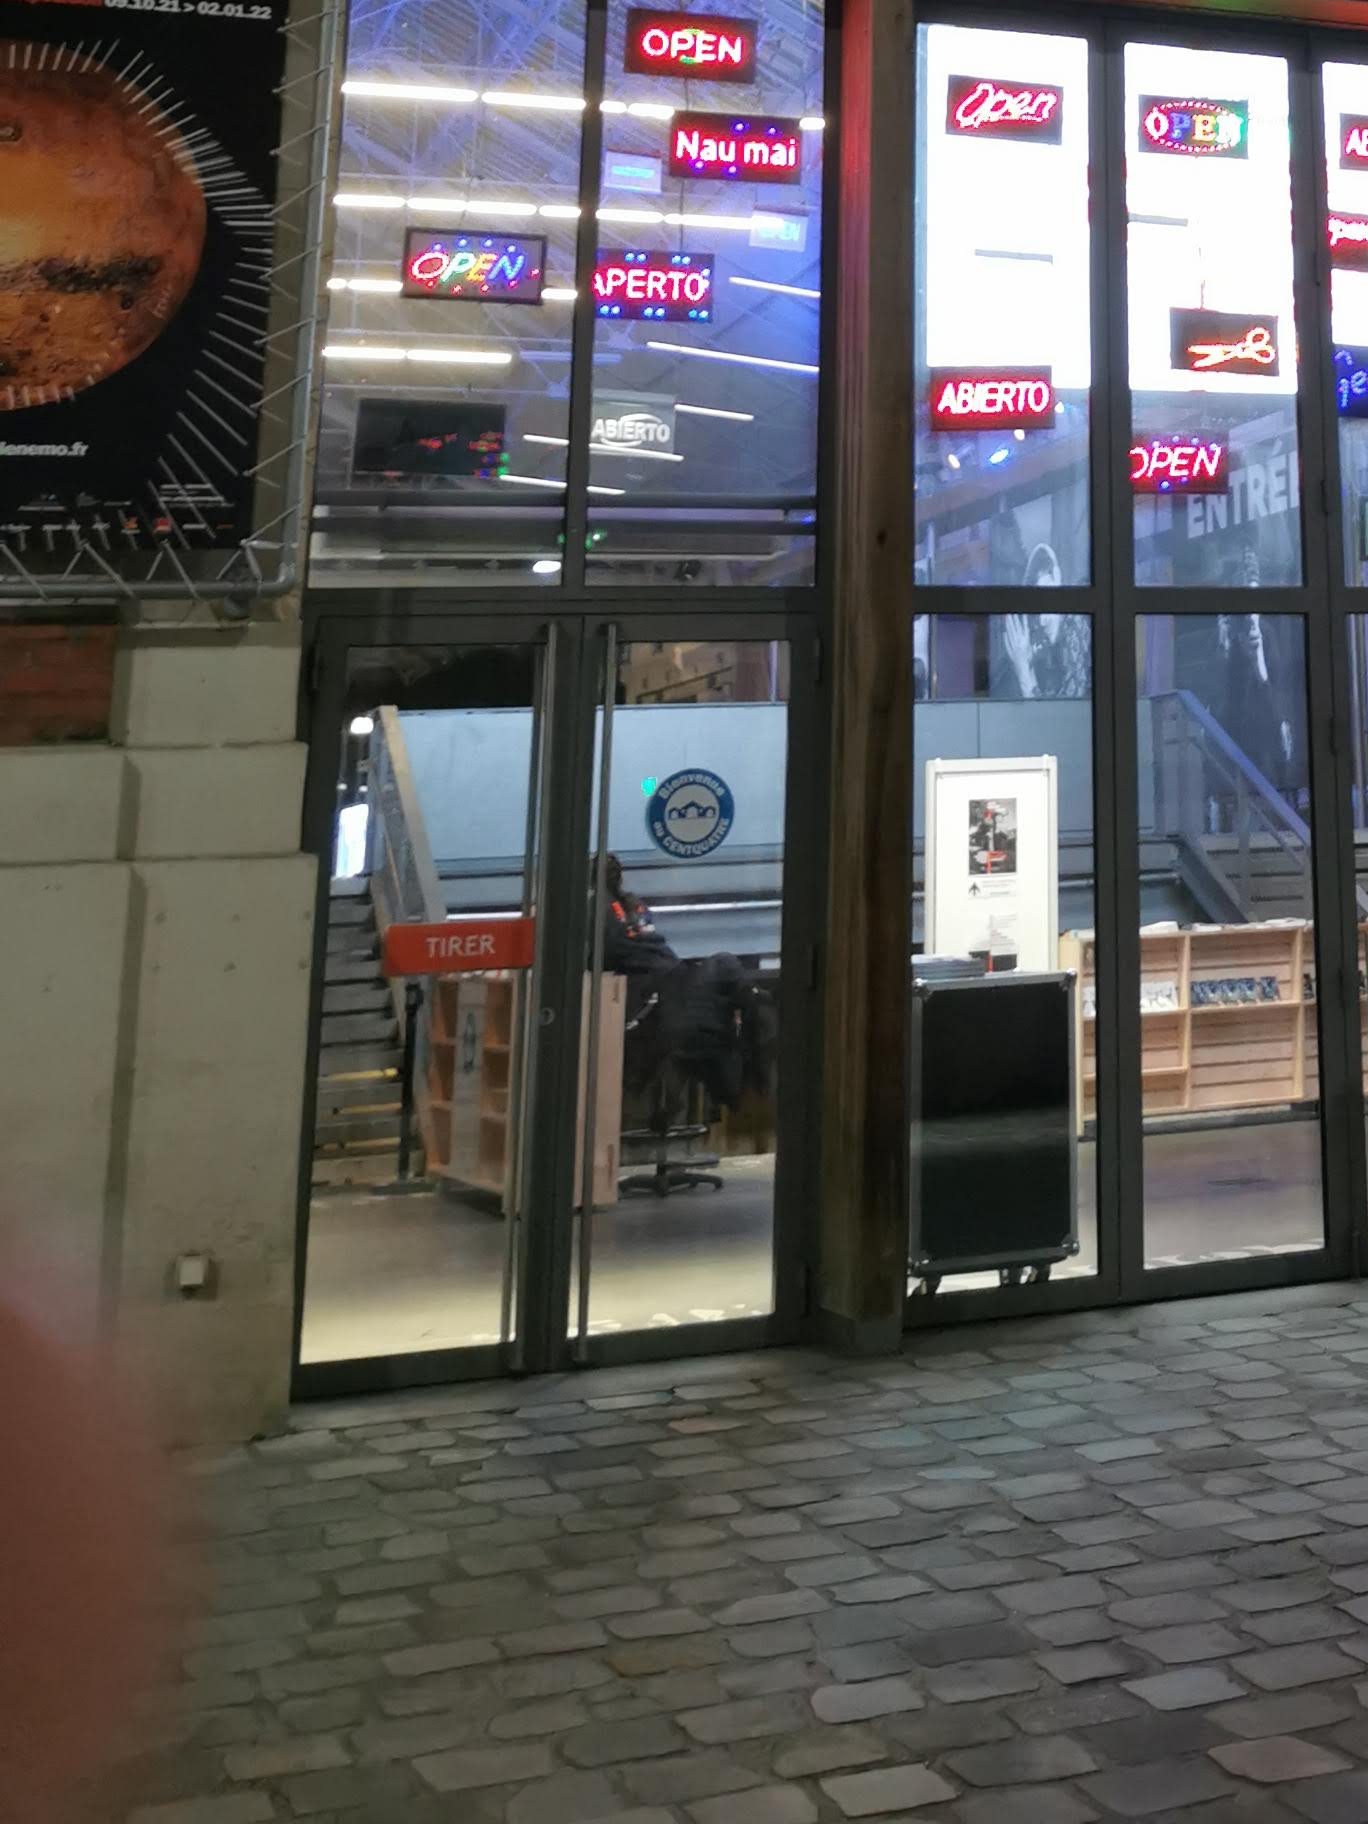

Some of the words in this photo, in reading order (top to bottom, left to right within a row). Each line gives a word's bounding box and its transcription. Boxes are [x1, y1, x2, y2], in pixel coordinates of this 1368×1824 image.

[197, 1, 272, 20] 02.01.22
[643, 28, 743, 64] OPEN
[955, 82, 1057, 127] Open
[676, 131, 735, 164] Nau
[744, 139, 797, 167] mai
[412, 251, 523, 282] OPEN
[938, 381, 1050, 415] ABIERTO
[592, 418, 669, 443] ABIERTO
[658, 773, 725, 800] Bienvenue
[426, 934, 496, 958] TIRER
